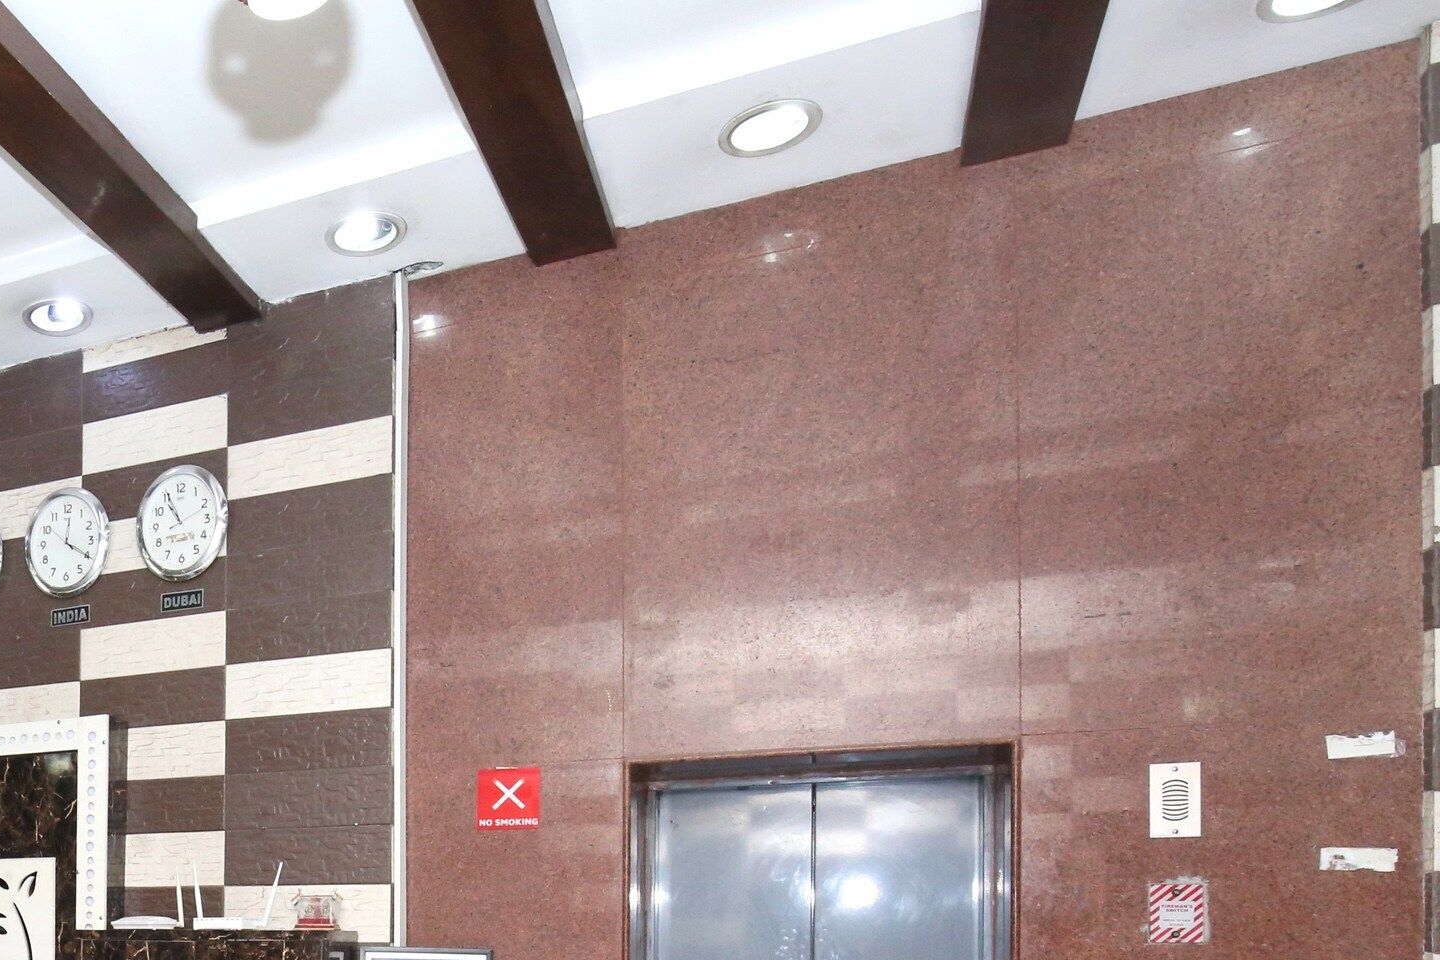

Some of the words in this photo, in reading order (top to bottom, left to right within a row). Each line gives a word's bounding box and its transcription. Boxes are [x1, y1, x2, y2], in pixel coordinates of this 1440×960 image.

[163, 592, 202, 610] DUBAI
[52, 608, 88, 624] INDIA
[495, 818, 538, 826] SMOKING
